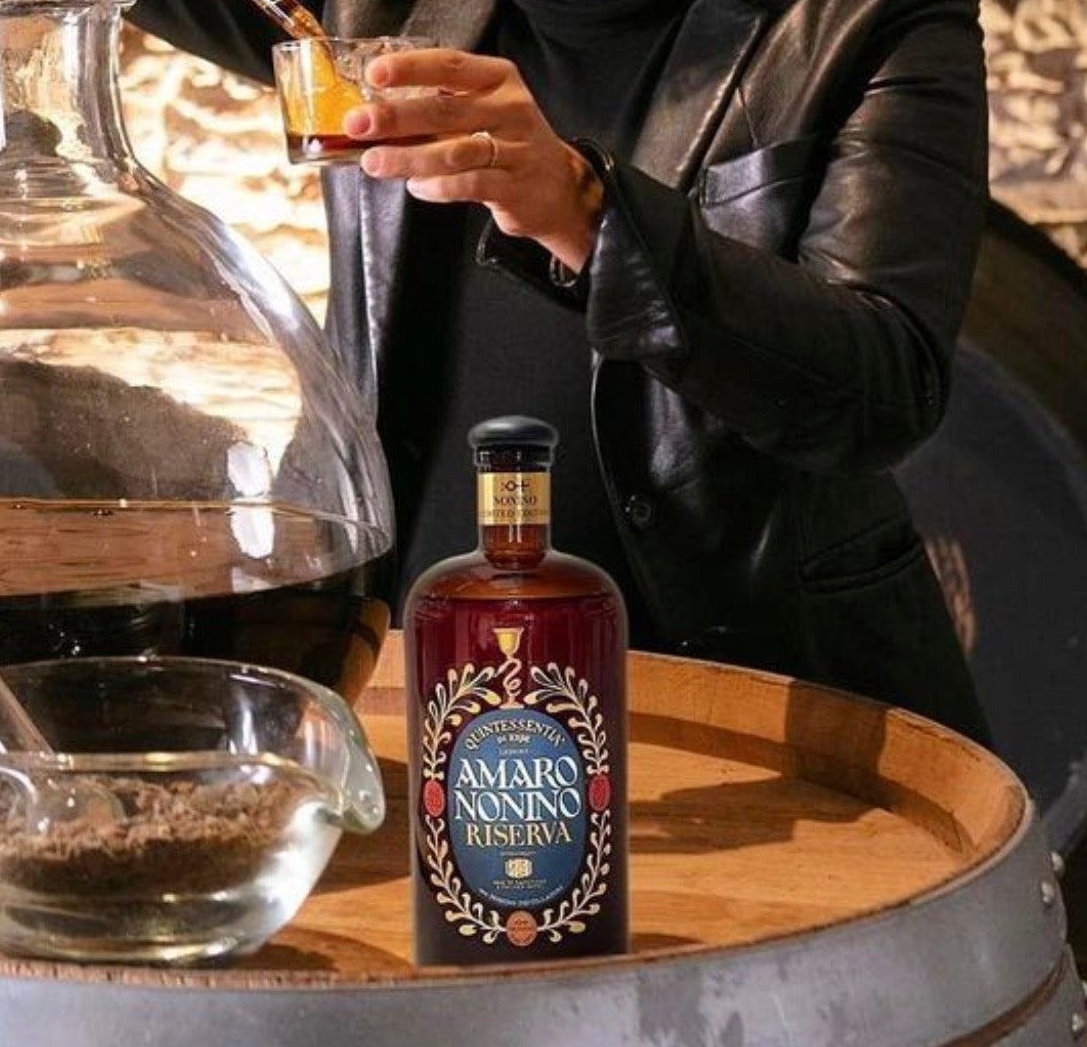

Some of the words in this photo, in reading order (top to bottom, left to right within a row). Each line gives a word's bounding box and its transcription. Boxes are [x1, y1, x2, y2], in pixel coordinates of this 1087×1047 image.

[494, 495, 537, 506] NONNO
[454, 756, 577, 789] AMARO
[454, 788, 581, 821] NONINO
[466, 821, 572, 848] RISERVA
